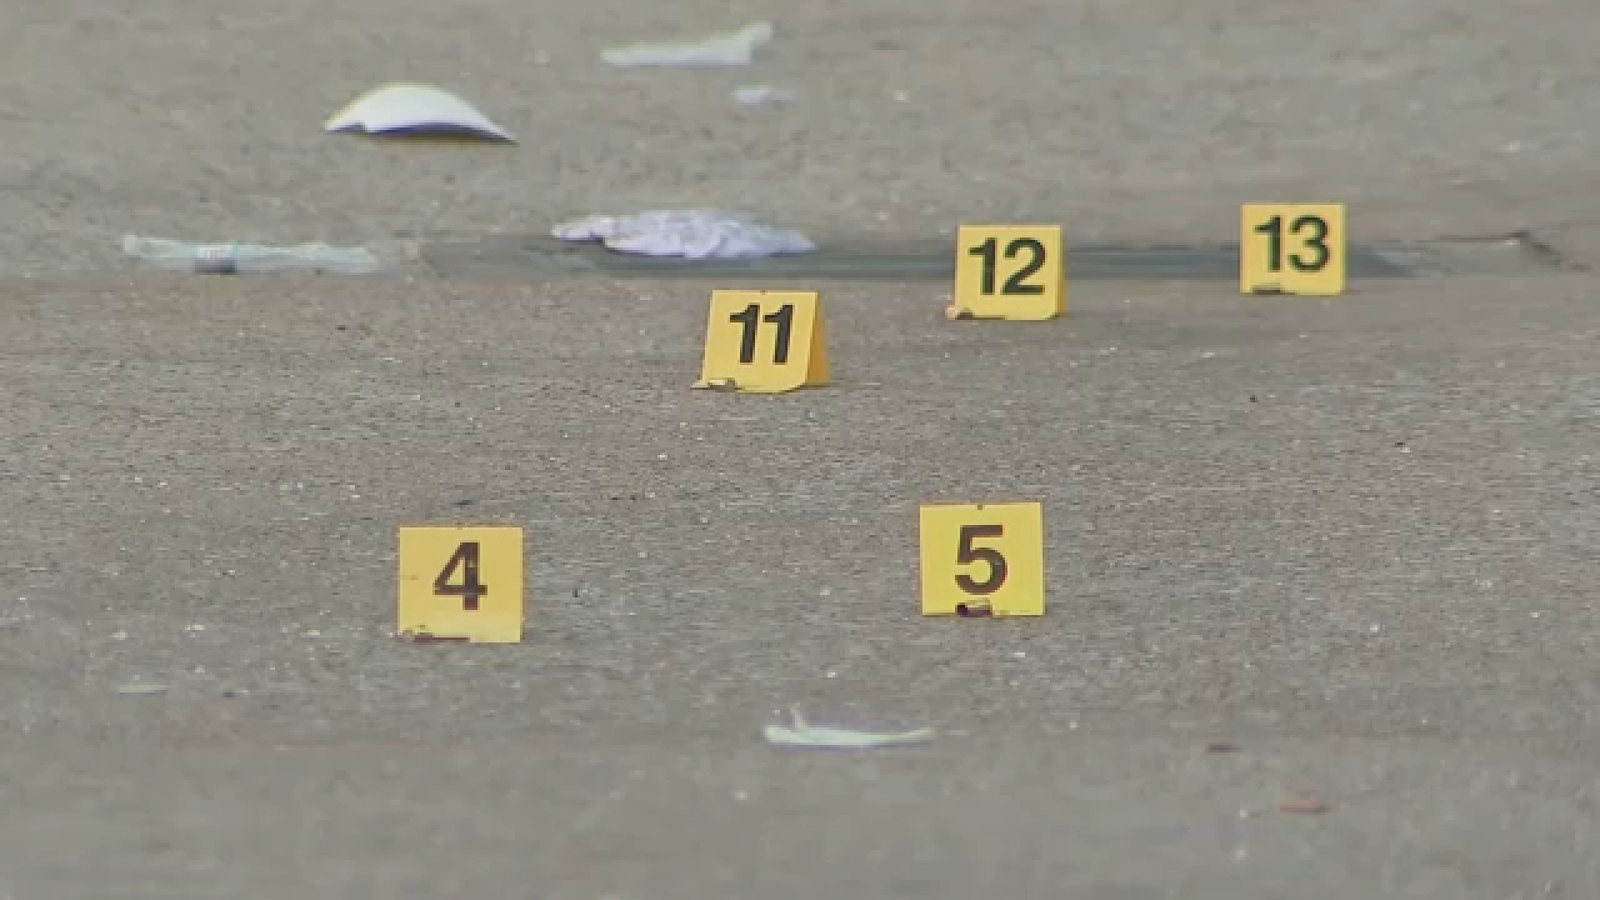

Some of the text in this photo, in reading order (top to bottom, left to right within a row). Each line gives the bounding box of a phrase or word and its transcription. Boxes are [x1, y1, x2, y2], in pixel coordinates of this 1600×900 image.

[968, 237, 1046, 296] 12
[1253, 215, 1331, 272] 13
[729, 304, 794, 364] 11
[433, 541, 488, 611] 4
[954, 524, 1008, 595] 5
